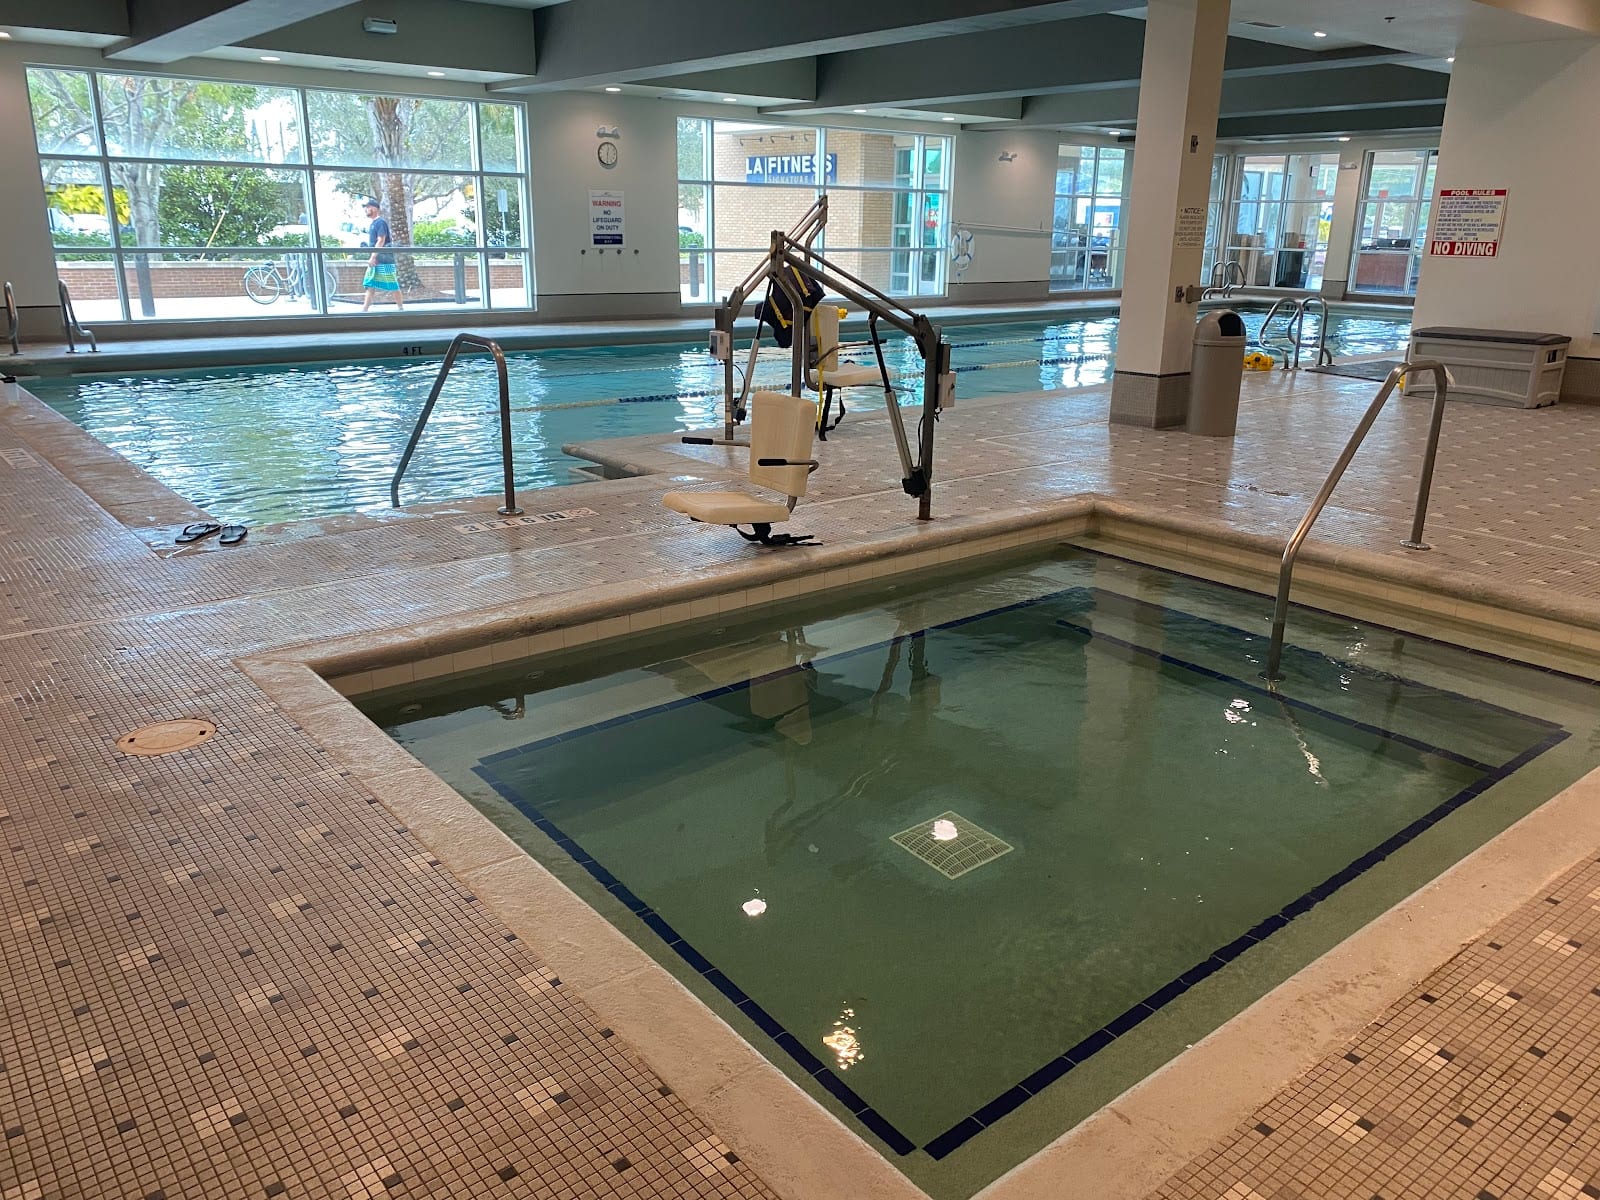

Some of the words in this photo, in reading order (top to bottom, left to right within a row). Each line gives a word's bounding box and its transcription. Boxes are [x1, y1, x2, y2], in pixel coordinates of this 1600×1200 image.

[745, 157, 763, 175] LA
[1183, 207, 1201, 215] NOTICE
[1433, 241, 1451, 255] NO
[1453, 242, 1494, 256] DIVING
[412, 346, 422, 355] FT
[463, 523, 480, 531] 3
[541, 513, 566, 521] IN
